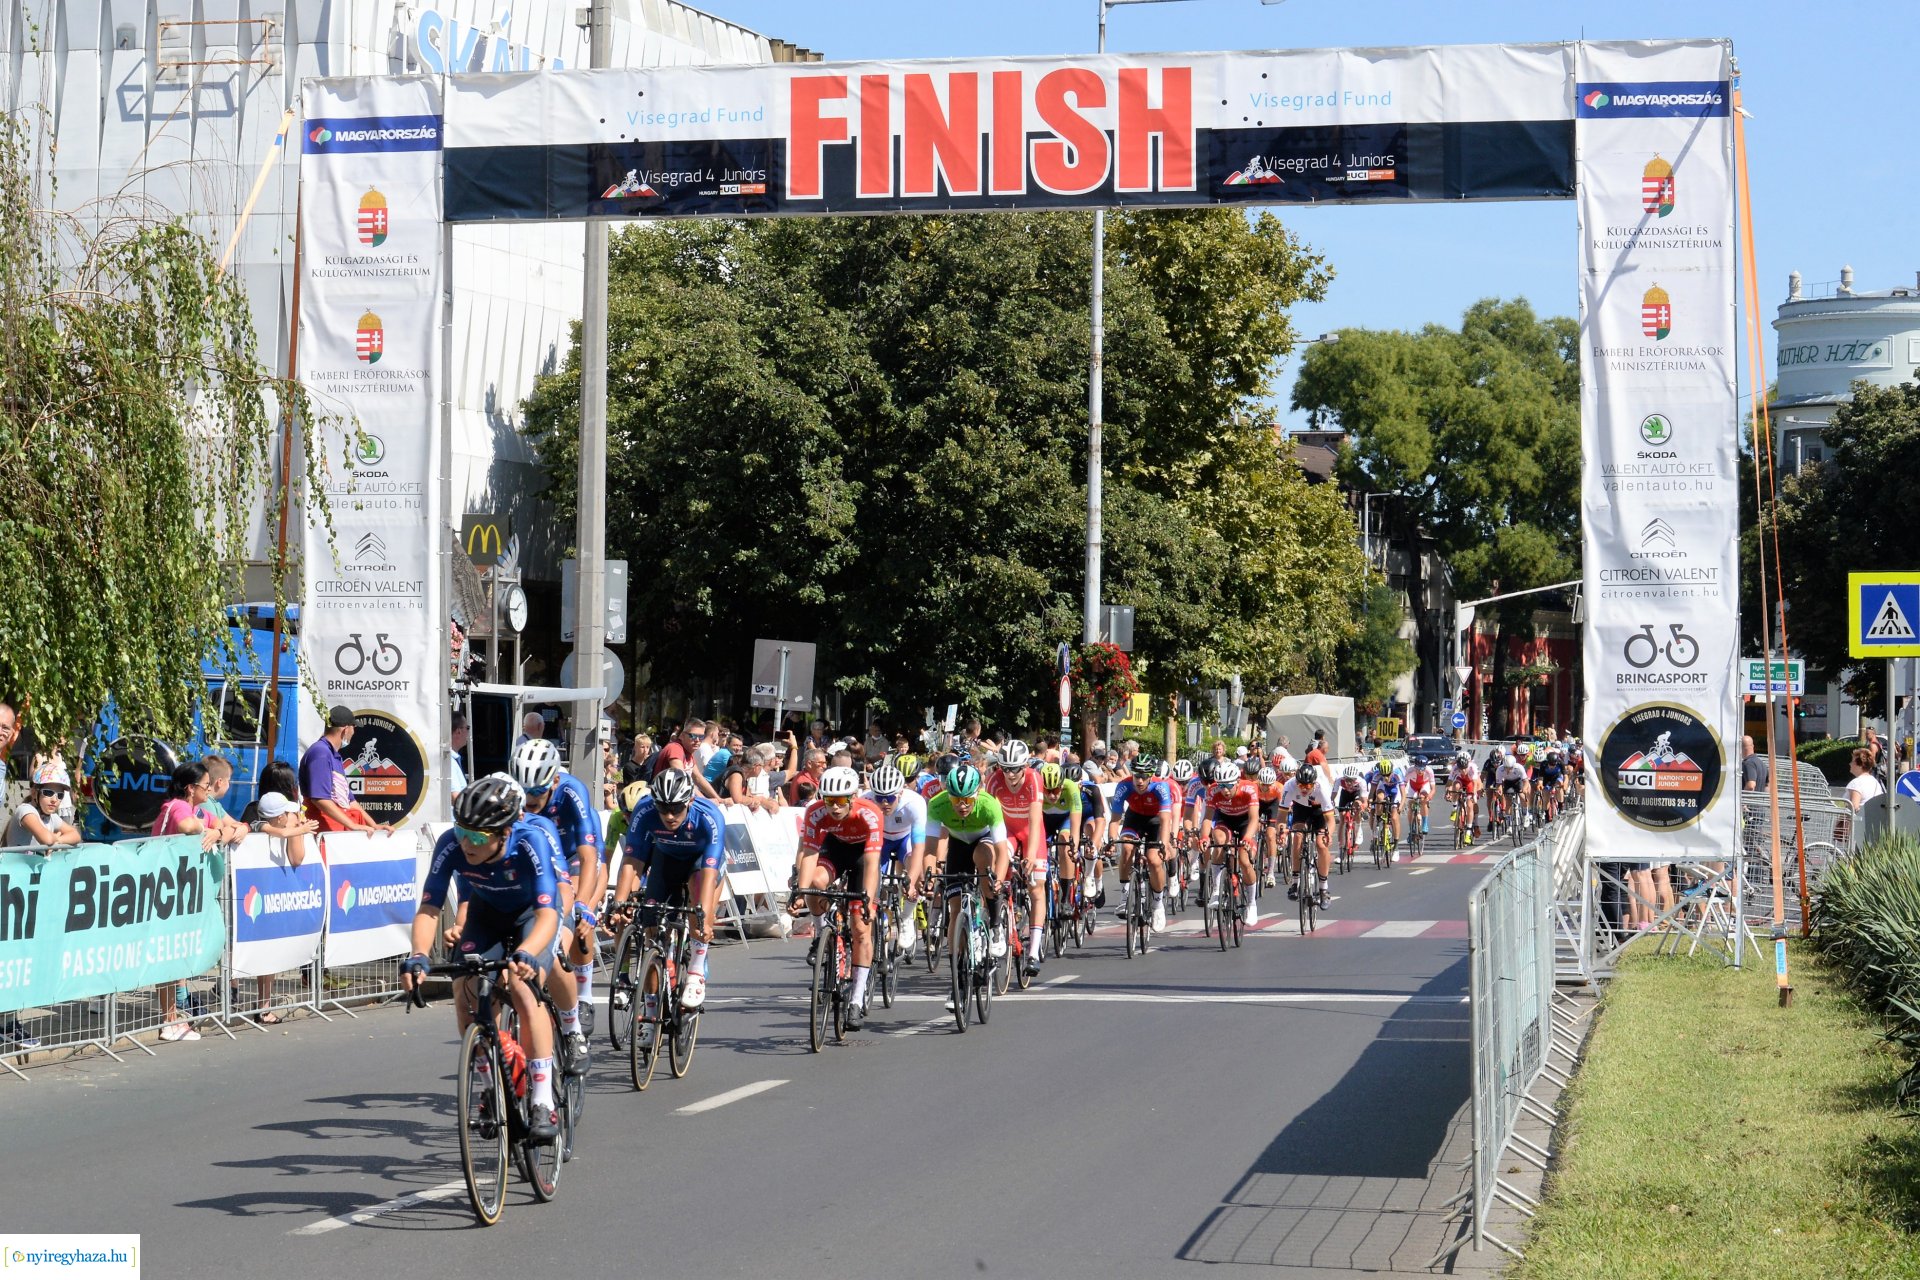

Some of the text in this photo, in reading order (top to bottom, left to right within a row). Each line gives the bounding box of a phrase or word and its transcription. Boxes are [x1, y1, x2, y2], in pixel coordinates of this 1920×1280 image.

[418, 9, 564, 73] SKÁ
[1250, 91, 1392, 111] Visegrad Fund
[1613, 91, 1722, 106] MAGYARORSZÁG
[627, 106, 763, 128] Visegrad Fund
[335, 125, 437, 142] MAGYARORSZÁG
[788, 66, 1193, 198] FINISH
[1263, 153, 1394, 173] Visegrad 4 Juniors
[639, 167, 766, 186] Visegrad 4 Juniors
[1607, 225, 1708, 236] KÜLGAZDASÁGI ÉS
[1593, 238, 1722, 250] KÜLÜGYMINISZTÉRIUM
[325, 253, 418, 266] KÜLGAZDASÁGI ÉS
[311, 267, 431, 278] KÜLÜGYMINISZTÉRIUM
[1593, 346, 1634, 357] EMBERI
[1778, 340, 1873, 366] UTHER HÁZ
[1610, 359, 1707, 371] MINISZTÉRIUMA
[310, 370, 349, 381] EMBERI
[326, 383, 414, 393] MINISZTÉRIUMA
[1636, 451, 1678, 459] ŠKODA
[352, 470, 389, 478] ŠKODA
[1601, 461, 1715, 475] VALENT AUTÓ KFT.
[321, 480, 423, 493] ALENT AUTÓ KFT.
[1602, 479, 1714, 492] valentauto.hu
[327, 498, 422, 509] alentauto.hu
[1600, 566, 1718, 582] CITROËN VALENT
[315, 578, 424, 593] CITROËN VALENT
[1601, 587, 1719, 599] citroenvalent.hu
[316, 599, 423, 609] citroenvalent.hu
[1616, 673, 1708, 684] BRINGASPORT
[328, 680, 410, 691] BRINGASPORT
[1631, 709, 1693, 726] VISEGRAD 4 JUNIORS
[372, 717, 396, 733] JUNIORS
[1378, 720, 1394, 737] 100
[101, 770, 172, 793] GMC
[349, 780, 362, 791] CI
[1624, 774, 1653, 786] UCI
[358, 802, 383, 811] GUSZTUS
[1622, 796, 1698, 808] 2020. AUGUSZTUS 26-28.
[64, 853, 205, 934] Bianchi
[358, 876, 417, 907] MAGYARORSZÁ
[62, 929, 203, 980] PASSIONE CELESTE
